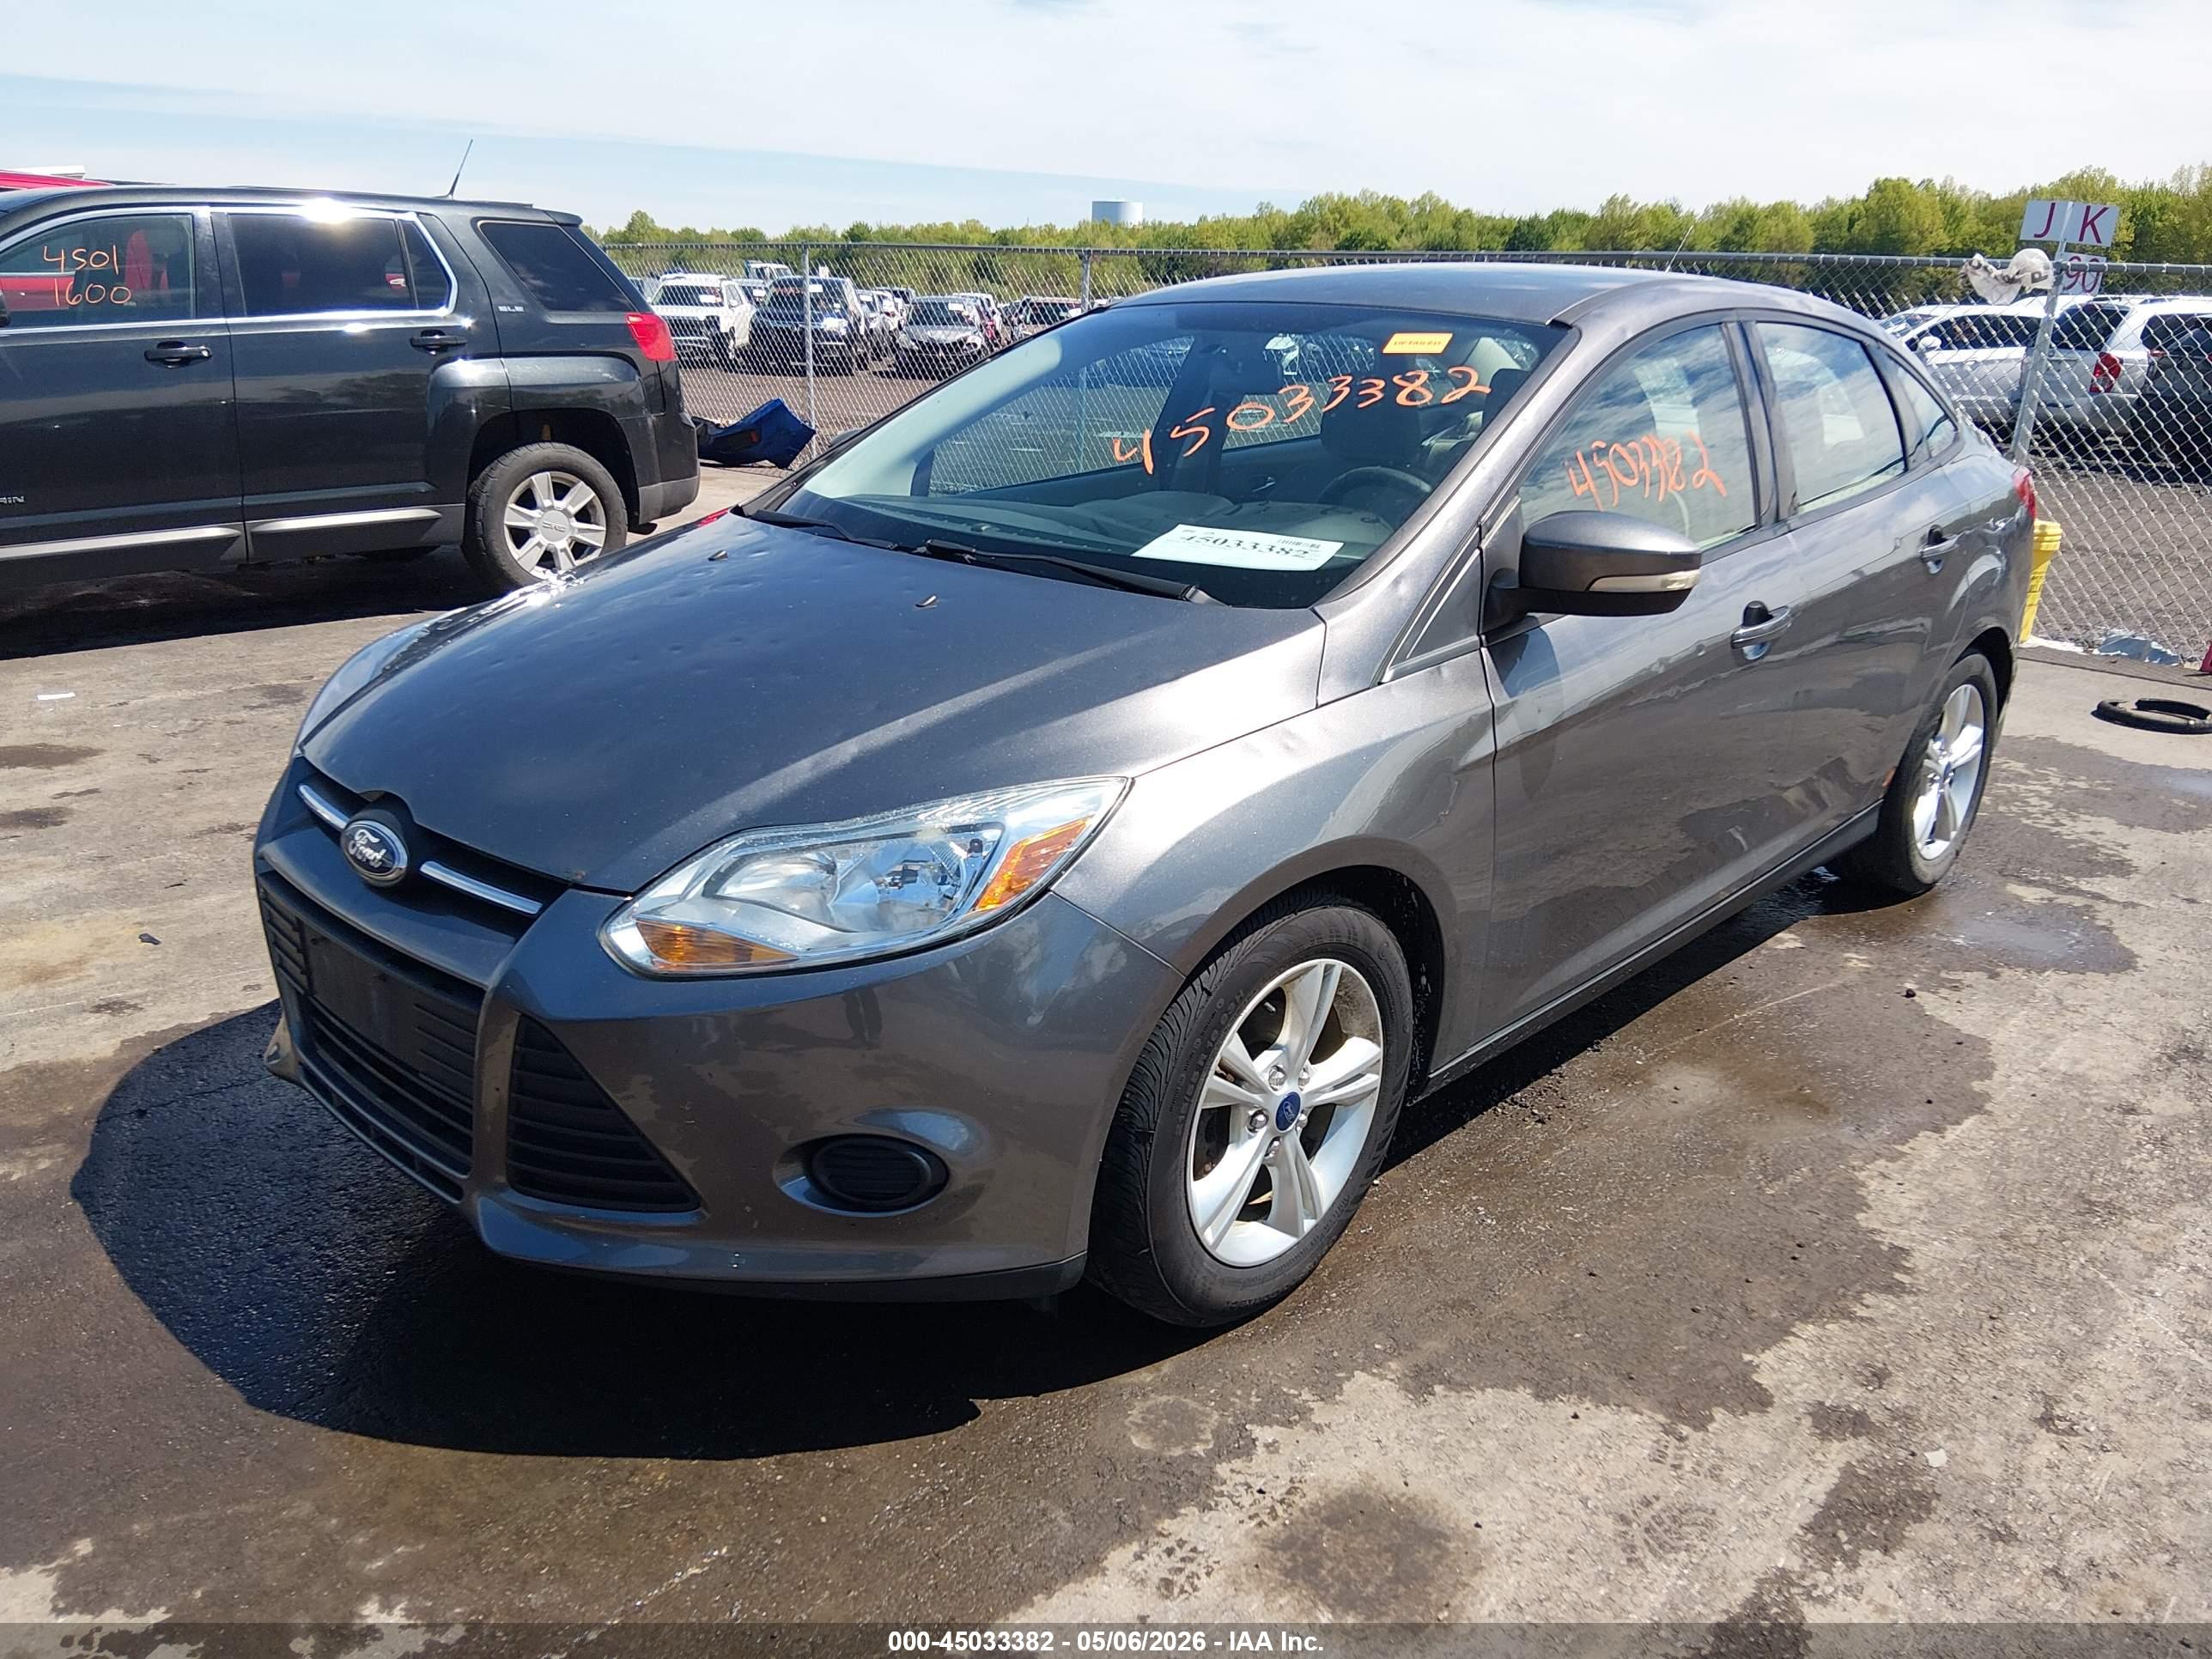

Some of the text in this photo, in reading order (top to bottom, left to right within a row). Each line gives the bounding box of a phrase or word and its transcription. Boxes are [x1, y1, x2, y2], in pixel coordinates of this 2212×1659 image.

[2033, 202, 2109, 244] J K
[44, 245, 119, 276] 4501
[54, 277, 131, 306] 1600
[1114, 366, 1492, 474] 45033382
[348, 830, 387, 868] Ford
